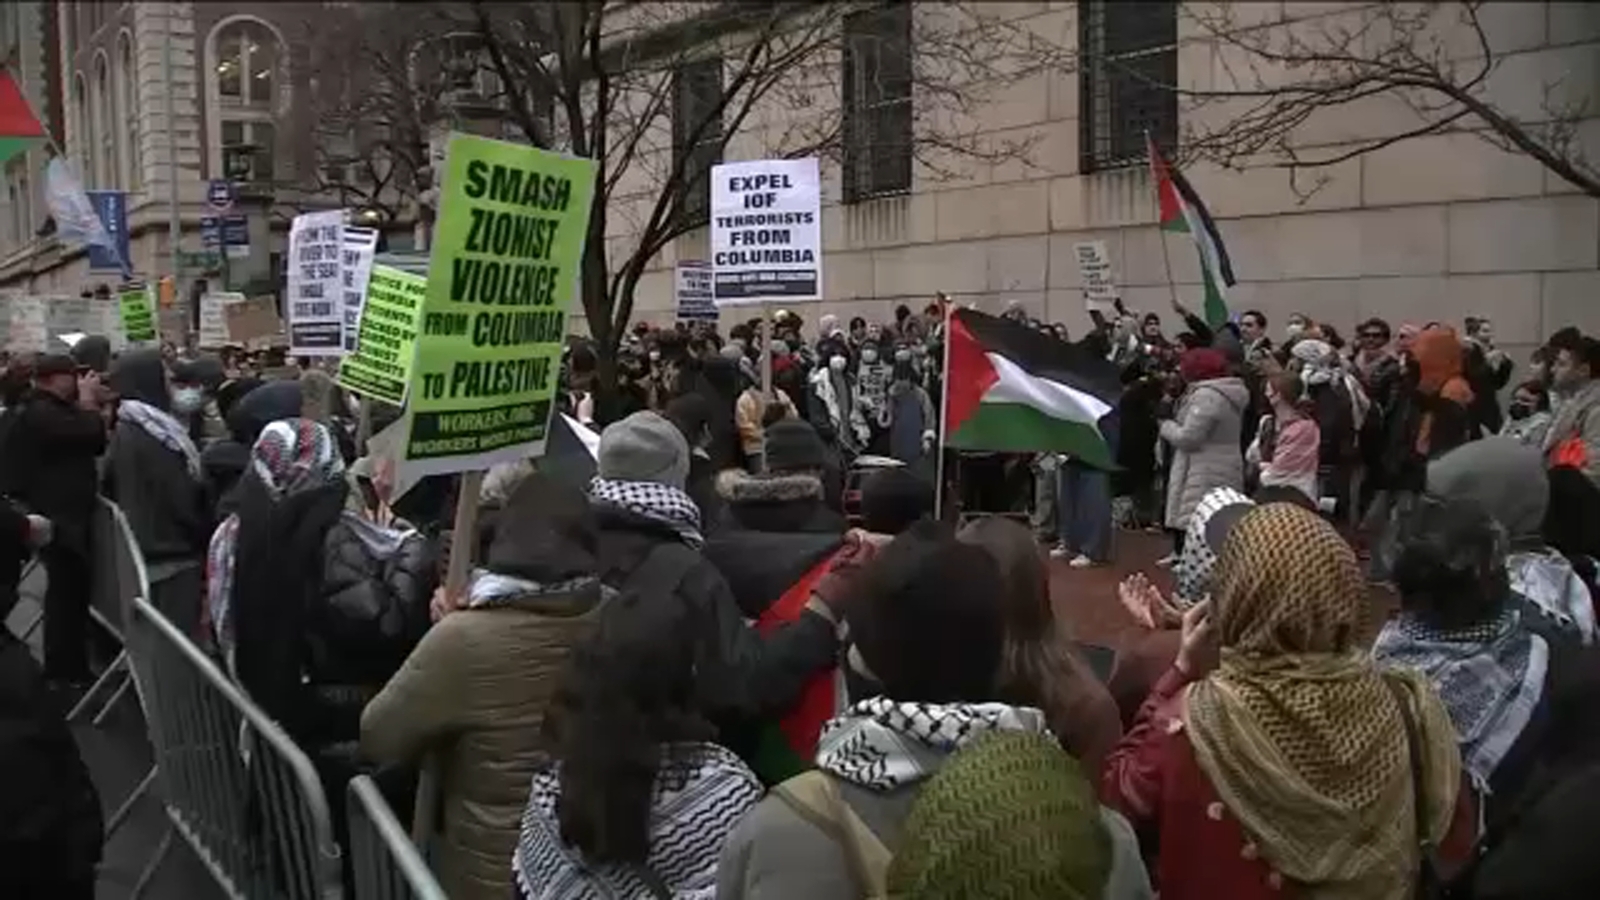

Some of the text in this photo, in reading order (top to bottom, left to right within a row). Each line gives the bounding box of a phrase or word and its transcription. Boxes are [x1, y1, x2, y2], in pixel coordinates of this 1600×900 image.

[464, 160, 571, 212] SMASH
[729, 174, 793, 192] EXPEL
[744, 193, 777, 209] IOF
[716, 212, 814, 228] TERRORISTS
[465, 209, 561, 260] ZIONIST
[730, 230, 791, 246] FROM
[715, 250, 815, 266] COLUMBIA
[451, 258, 560, 306] VIOLENCE
[424, 311, 564, 347] FROM COLUMBIA
[422, 373, 445, 399] TO
[450, 357, 551, 398] PALESTINE
